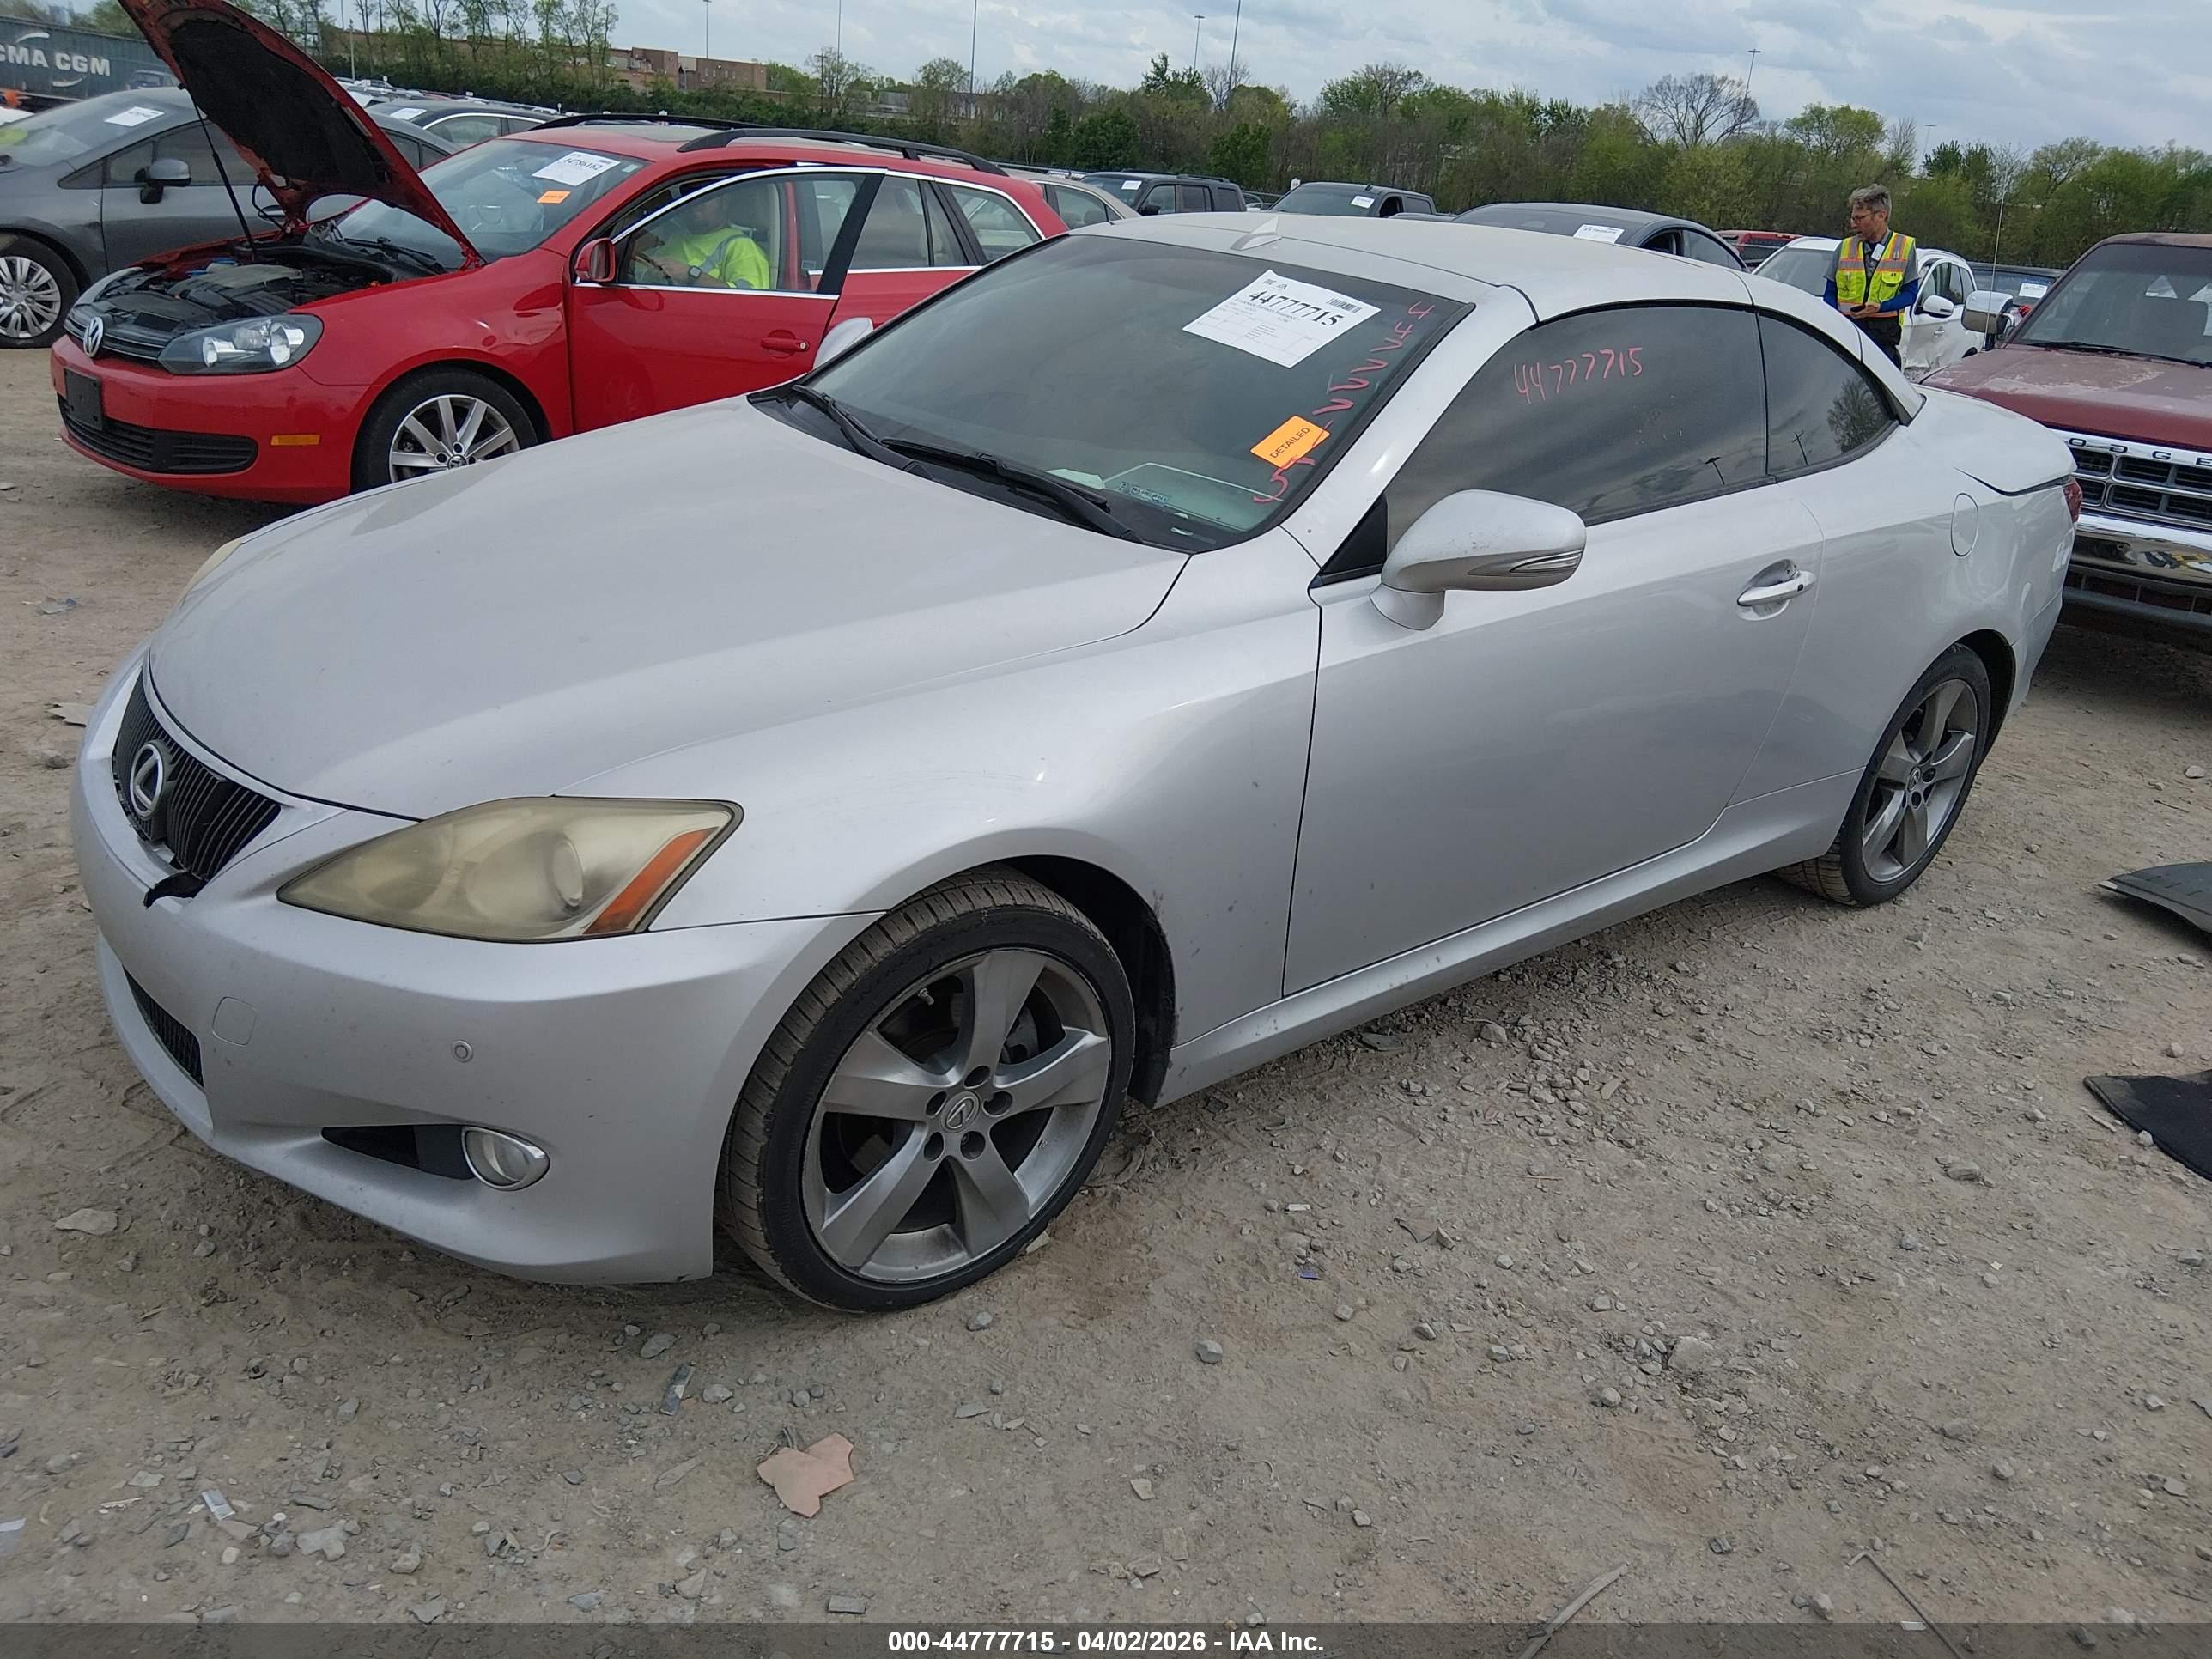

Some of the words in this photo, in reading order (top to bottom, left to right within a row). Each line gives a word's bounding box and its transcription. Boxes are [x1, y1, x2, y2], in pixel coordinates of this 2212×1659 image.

[55, 52, 110, 76] CGM
[1249, 290, 1344, 326] 44777715
[1514, 347, 1643, 404] 44777715
[1270, 427, 1310, 459] DETAILED
[2069, 437, 2212, 466] ODGE
